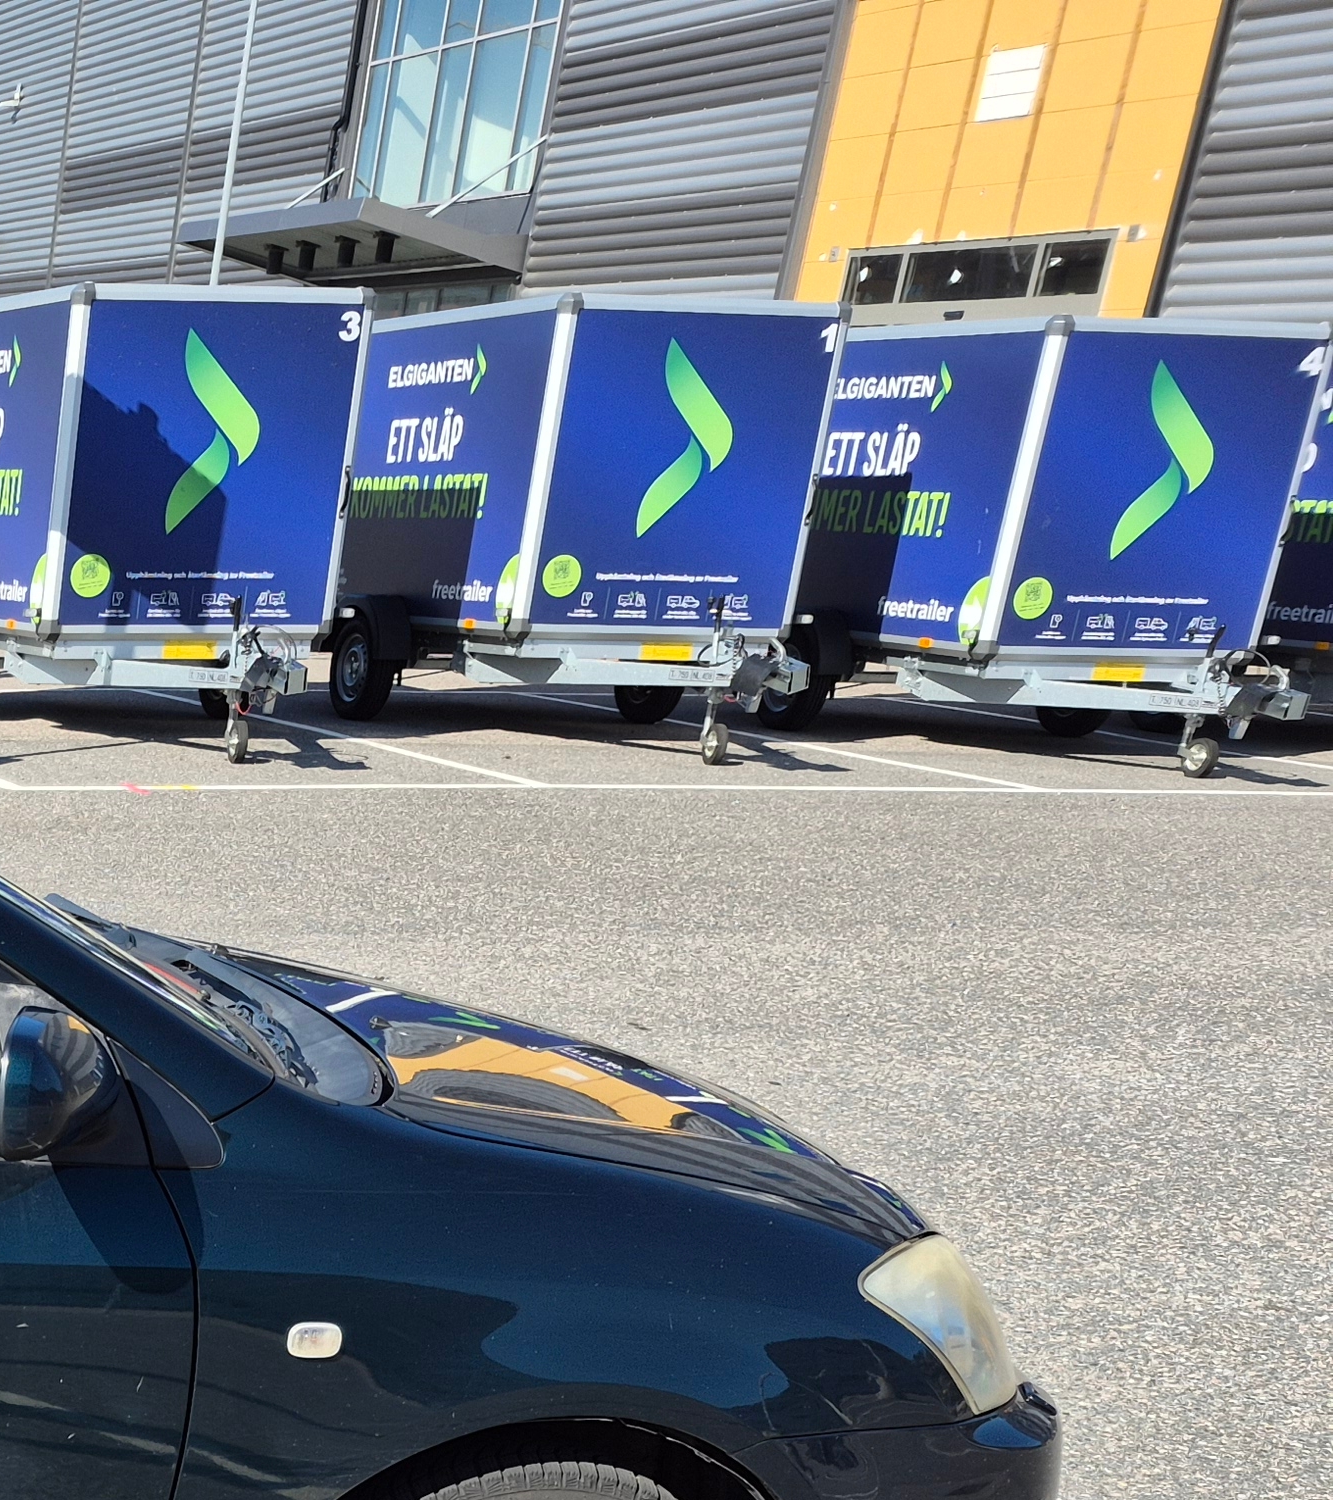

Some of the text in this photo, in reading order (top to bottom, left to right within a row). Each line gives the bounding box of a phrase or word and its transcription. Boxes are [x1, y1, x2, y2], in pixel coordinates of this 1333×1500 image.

[338, 310, 361, 342] 3
[820, 323, 838, 353] 1
[388, 358, 474, 388] ELGIGANTEN
[1298, 346, 1326, 377] 4
[386, 406, 464, 464] ETT SLÄP
[822, 423, 921, 477] ETT SLÄP
[349, 473, 489, 520] KOMMER LASTAT!
[862, 490, 951, 538] LASTAT!
[432, 579, 493, 603] freetrailer
[877, 596, 955, 622] freetrailer
[1266, 601, 1333, 624] freetrai
